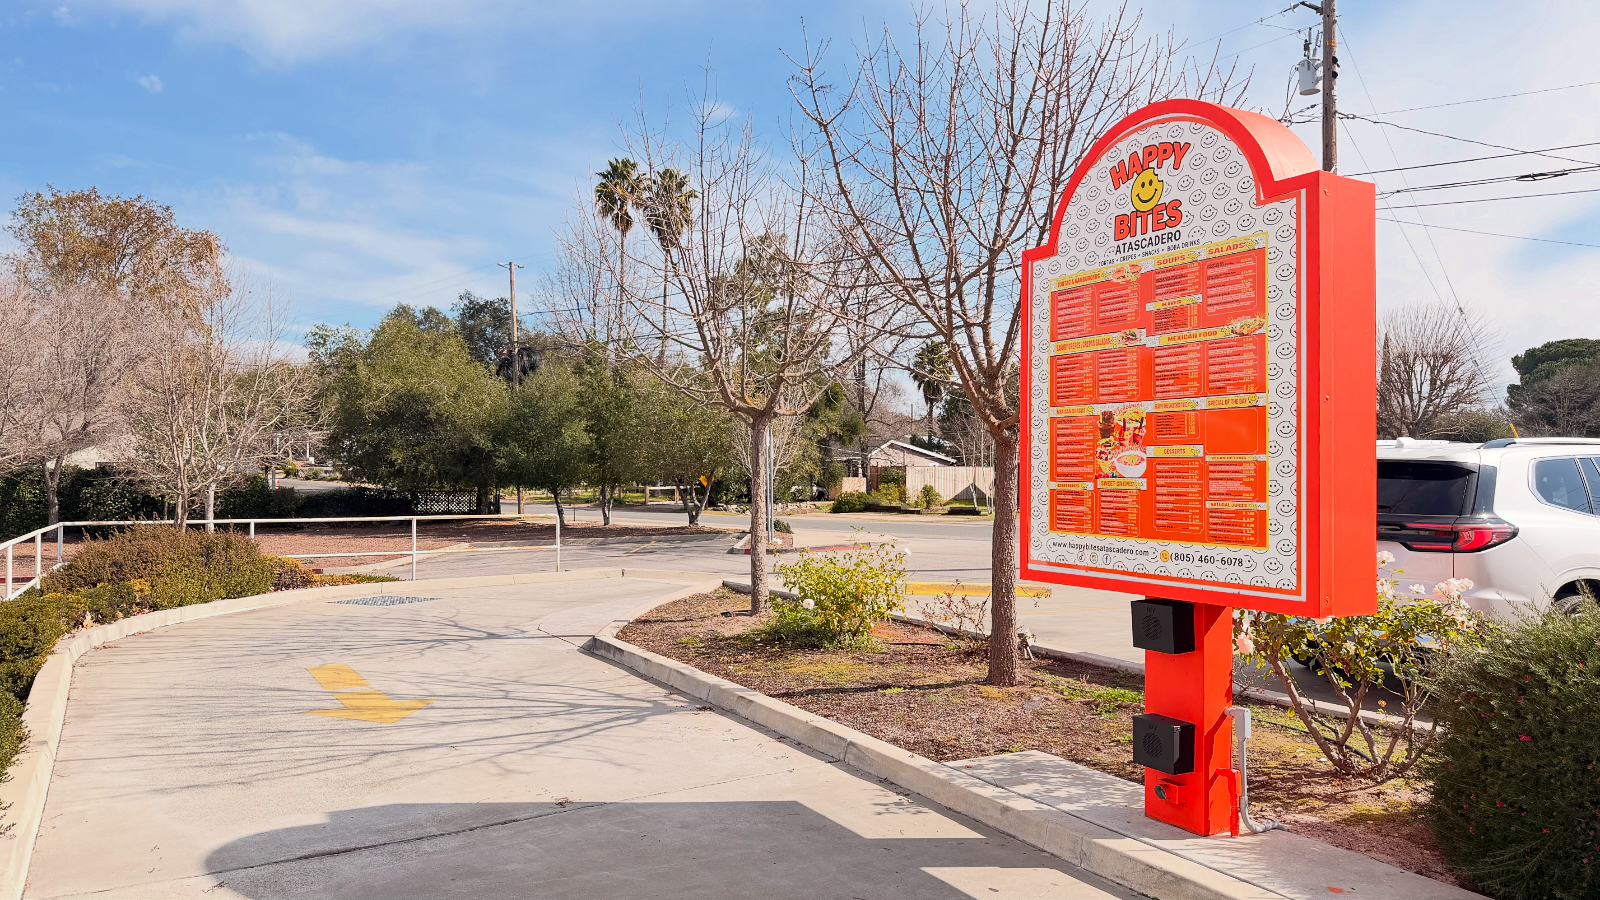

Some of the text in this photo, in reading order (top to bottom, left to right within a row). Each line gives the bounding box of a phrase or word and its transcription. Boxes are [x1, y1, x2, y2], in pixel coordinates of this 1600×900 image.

[1109, 141, 1191, 190] HAPPY
[1114, 199, 1182, 241] BITES
[1115, 230, 1181, 255] ATASCADERO
[1208, 242, 1245, 255] SALADS
[1098, 258, 1114, 267] TORTAS
[1120, 253, 1136, 262] CREPES
[1142, 248, 1160, 258] SNACKS
[1181, 238, 1200, 249] DRINKS
[1156, 255, 1186, 266] SOUPS
[1162, 299, 1182, 307] KIDS
[1167, 330, 1218, 342] MEXICAN FOOD
[1208, 399, 1224, 407] SPECIAL
[1052, 541, 1149, 556] www.happybitesatascadero.com
[1170, 552, 1244, 567] (805) 460-6078
